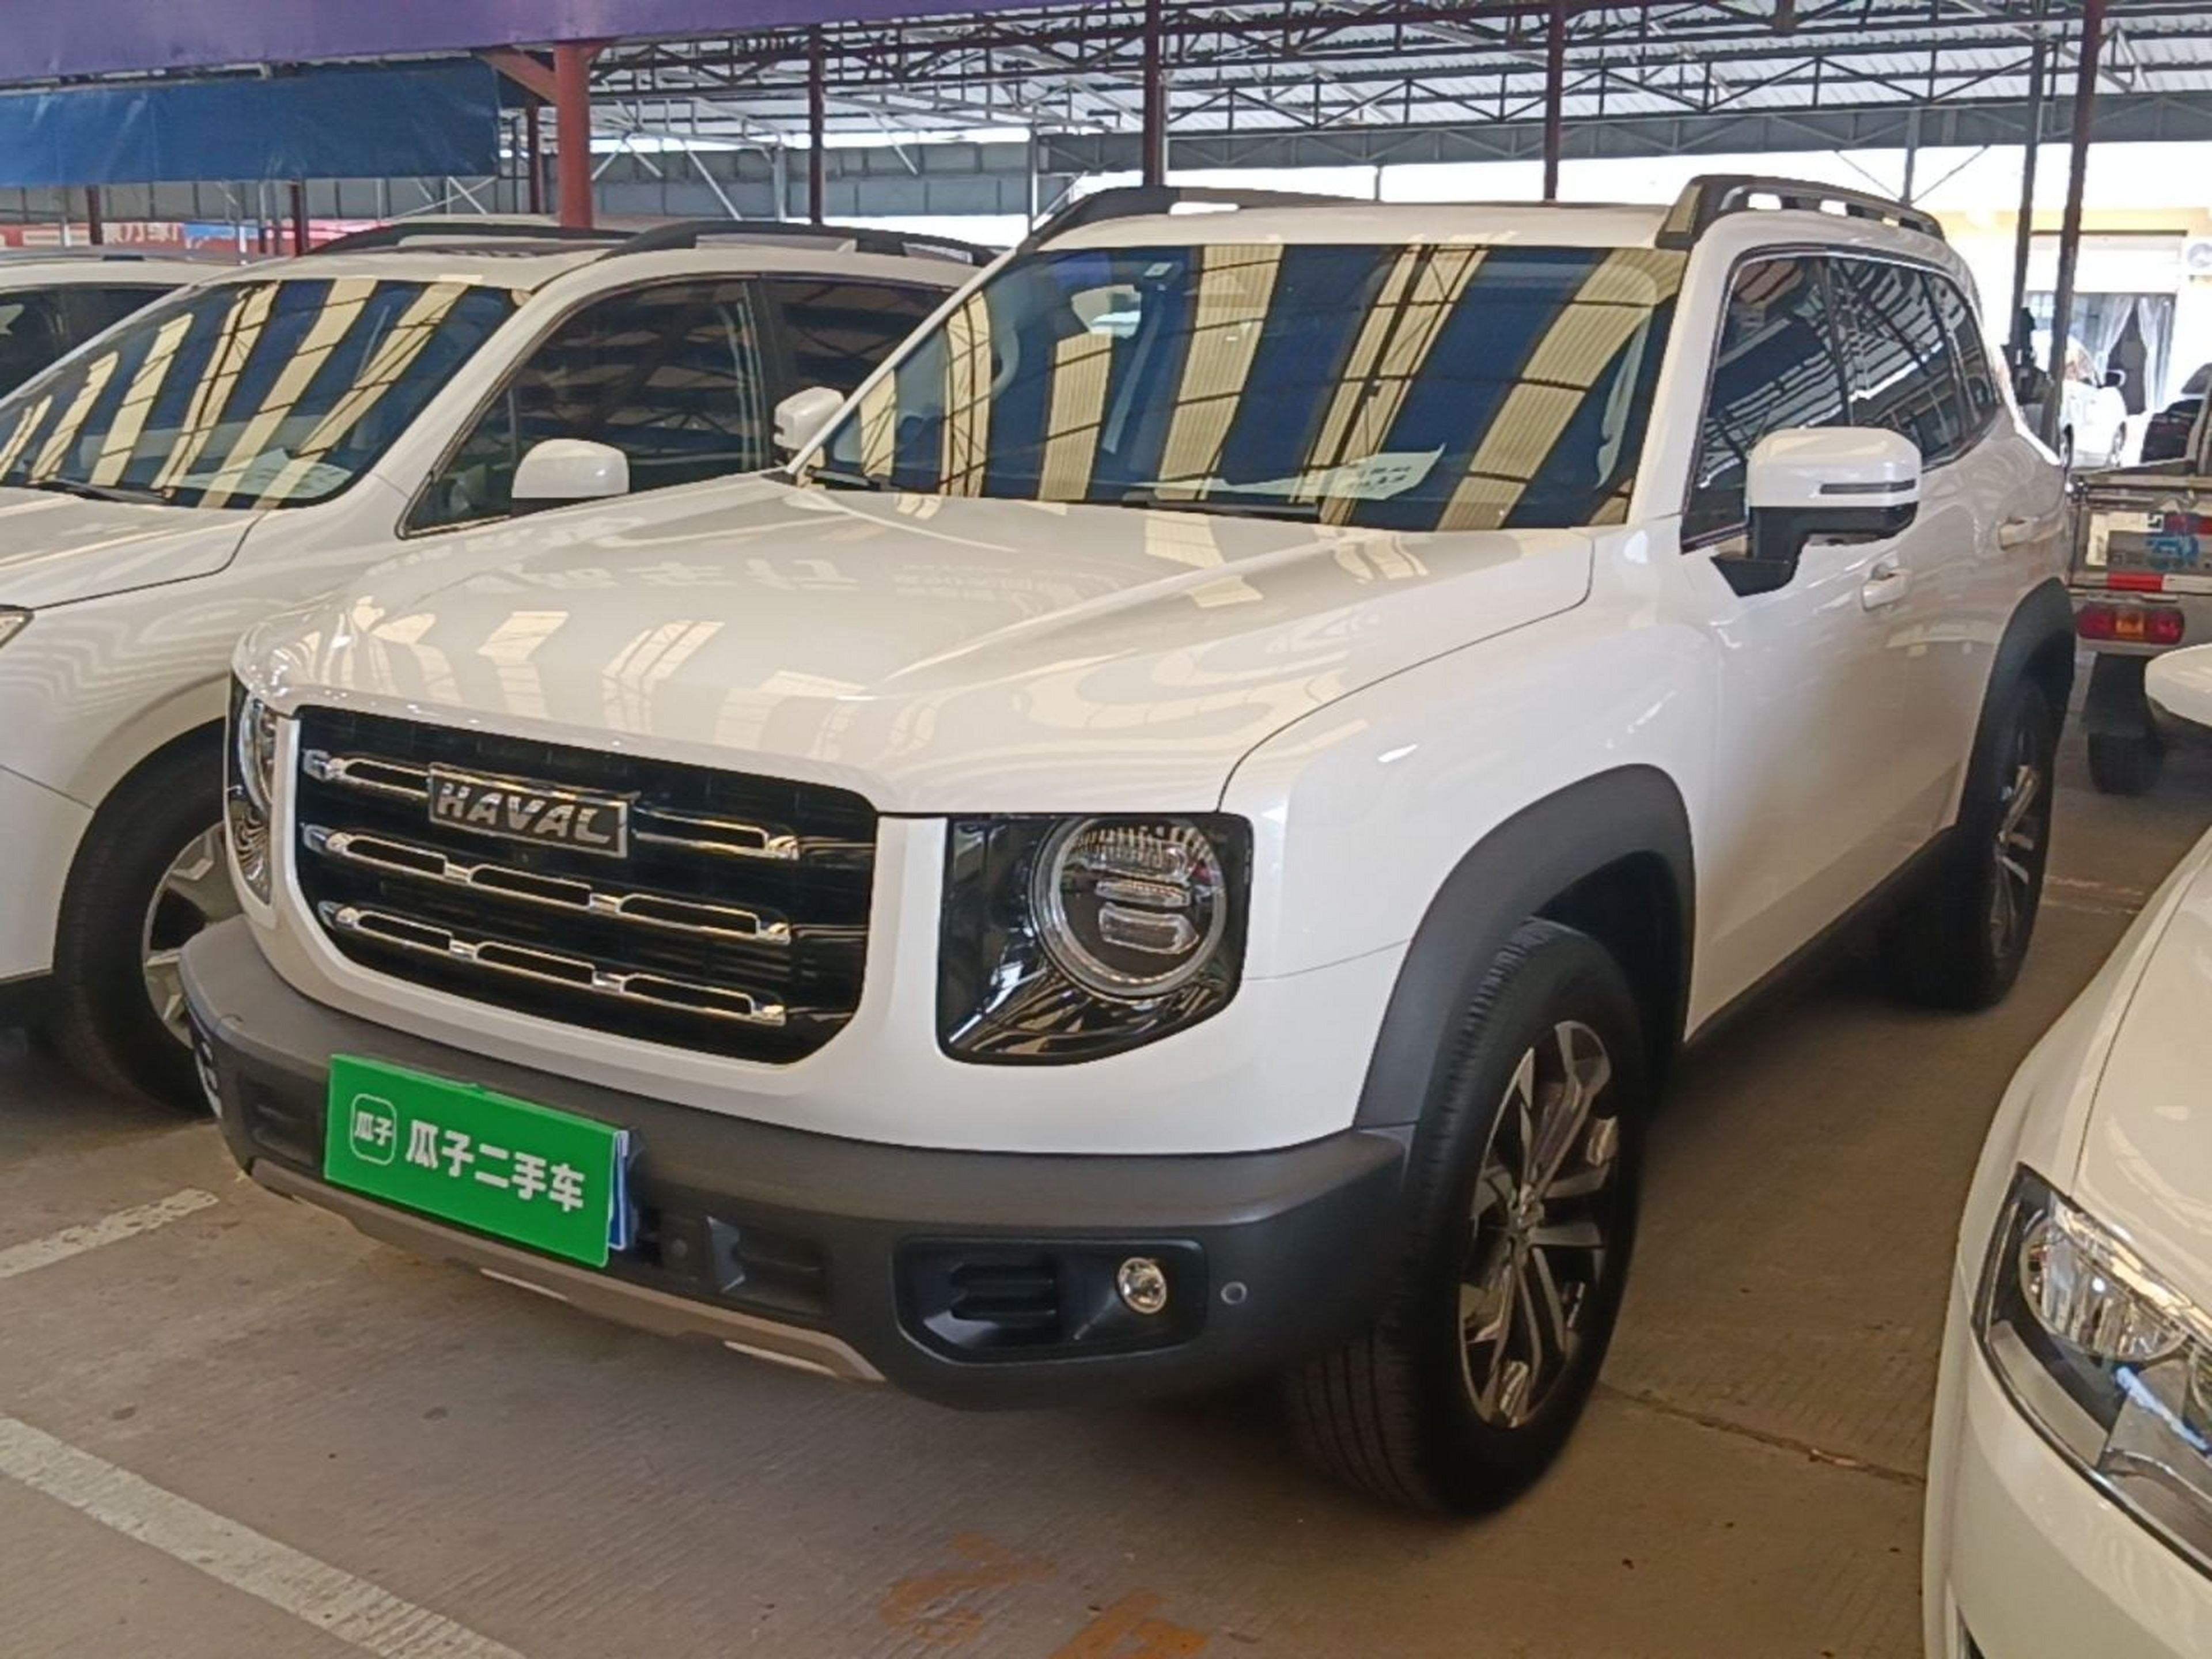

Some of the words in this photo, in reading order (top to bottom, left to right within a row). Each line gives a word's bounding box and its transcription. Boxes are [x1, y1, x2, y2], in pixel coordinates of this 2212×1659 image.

[437, 782, 611, 844] HAVAL
[354, 1111, 393, 1146] 瓜子
[406, 1120, 585, 1212] 瓜子二手车
